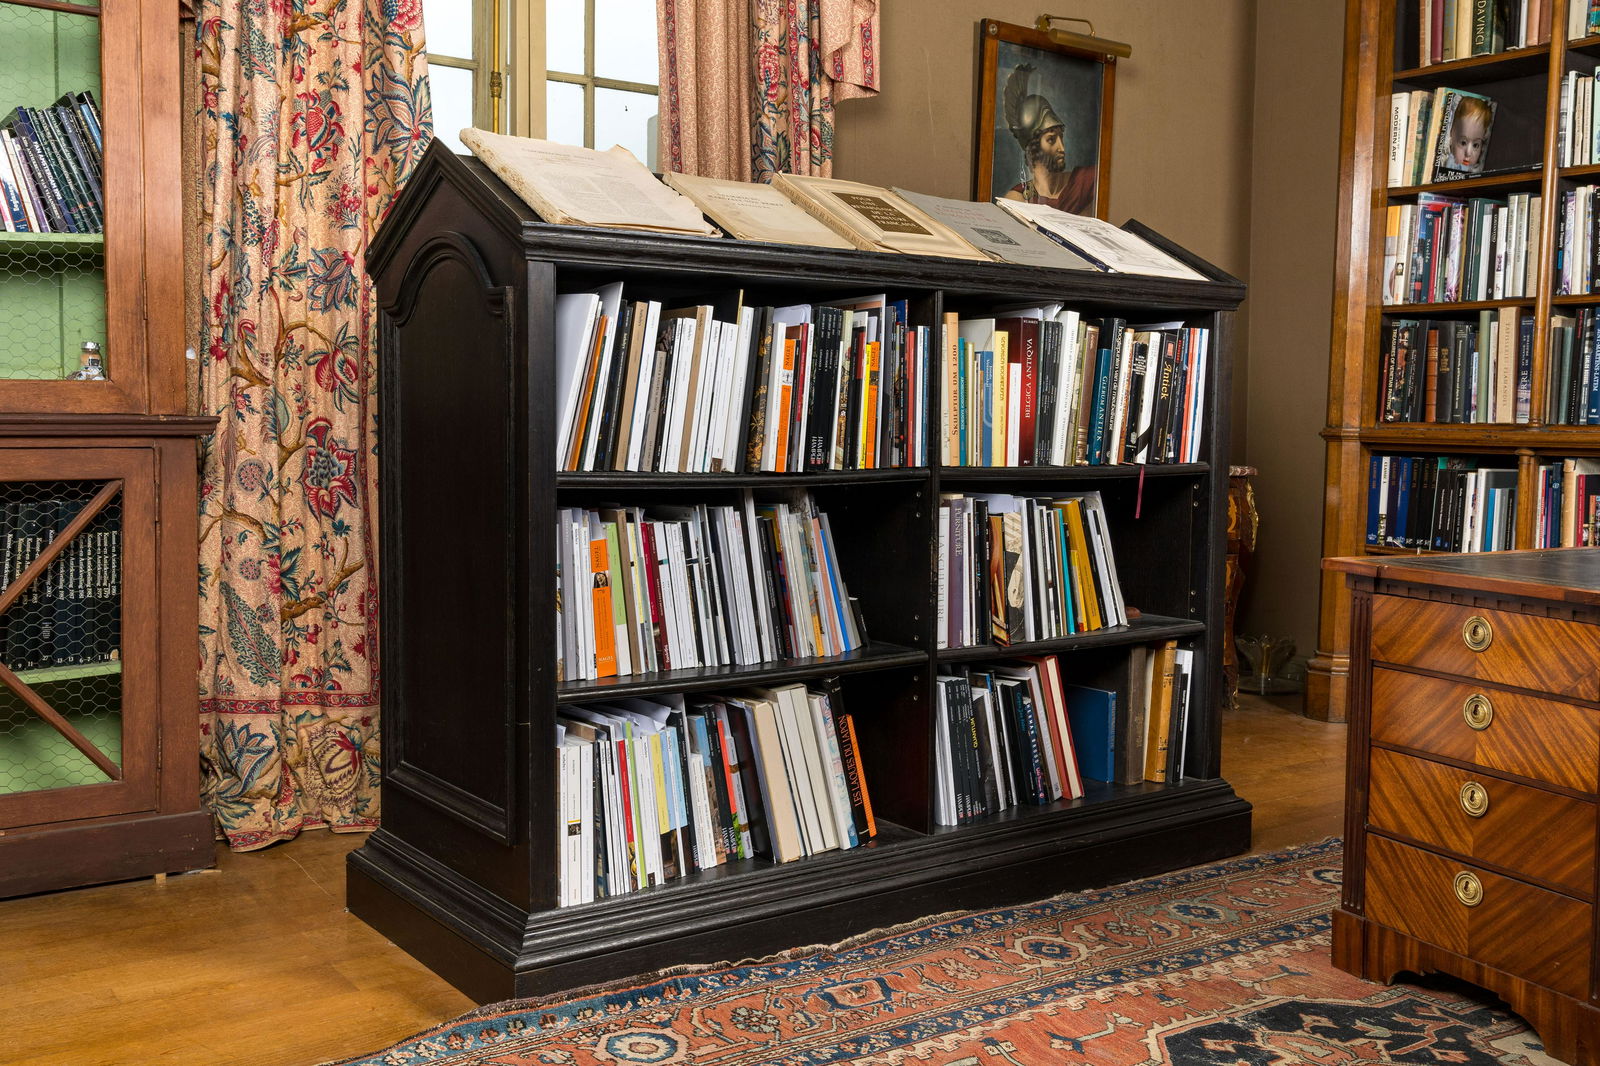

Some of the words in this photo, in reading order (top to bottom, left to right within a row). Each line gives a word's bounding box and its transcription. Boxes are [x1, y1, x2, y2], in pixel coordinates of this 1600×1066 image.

[1474, 14, 1487, 46] VINCI
[1437, 132, 1446, 154] GROSSE
[36, 154, 56, 188] AMSTERDAM
[1025, 337, 1034, 380] ANTIQVA
[1113, 325, 1124, 369] hoogtepunten
[1390, 328, 1398, 357] TREASURES
[952, 371, 958, 385] UM
[1098, 376, 1109, 406] GLERUM
[1160, 360, 1173, 401] Antiek
[1387, 364, 1395, 388] VENETIAN
[1519, 370, 1529, 402] VERRE
[951, 389, 959, 436] SKULPTUR
[1024, 382, 1032, 418] BELGICA
[1108, 391, 1118, 431] meubelkunst
[1096, 407, 1106, 442] ANTIEK
[954, 507, 963, 557] FURNITURE
[937, 552, 945, 623] SCULPTURE
[969, 717, 978, 748] QUANTUM
[845, 742, 853, 757] DU
[847, 757, 860, 789] LAQUES
[854, 791, 863, 807] LES
